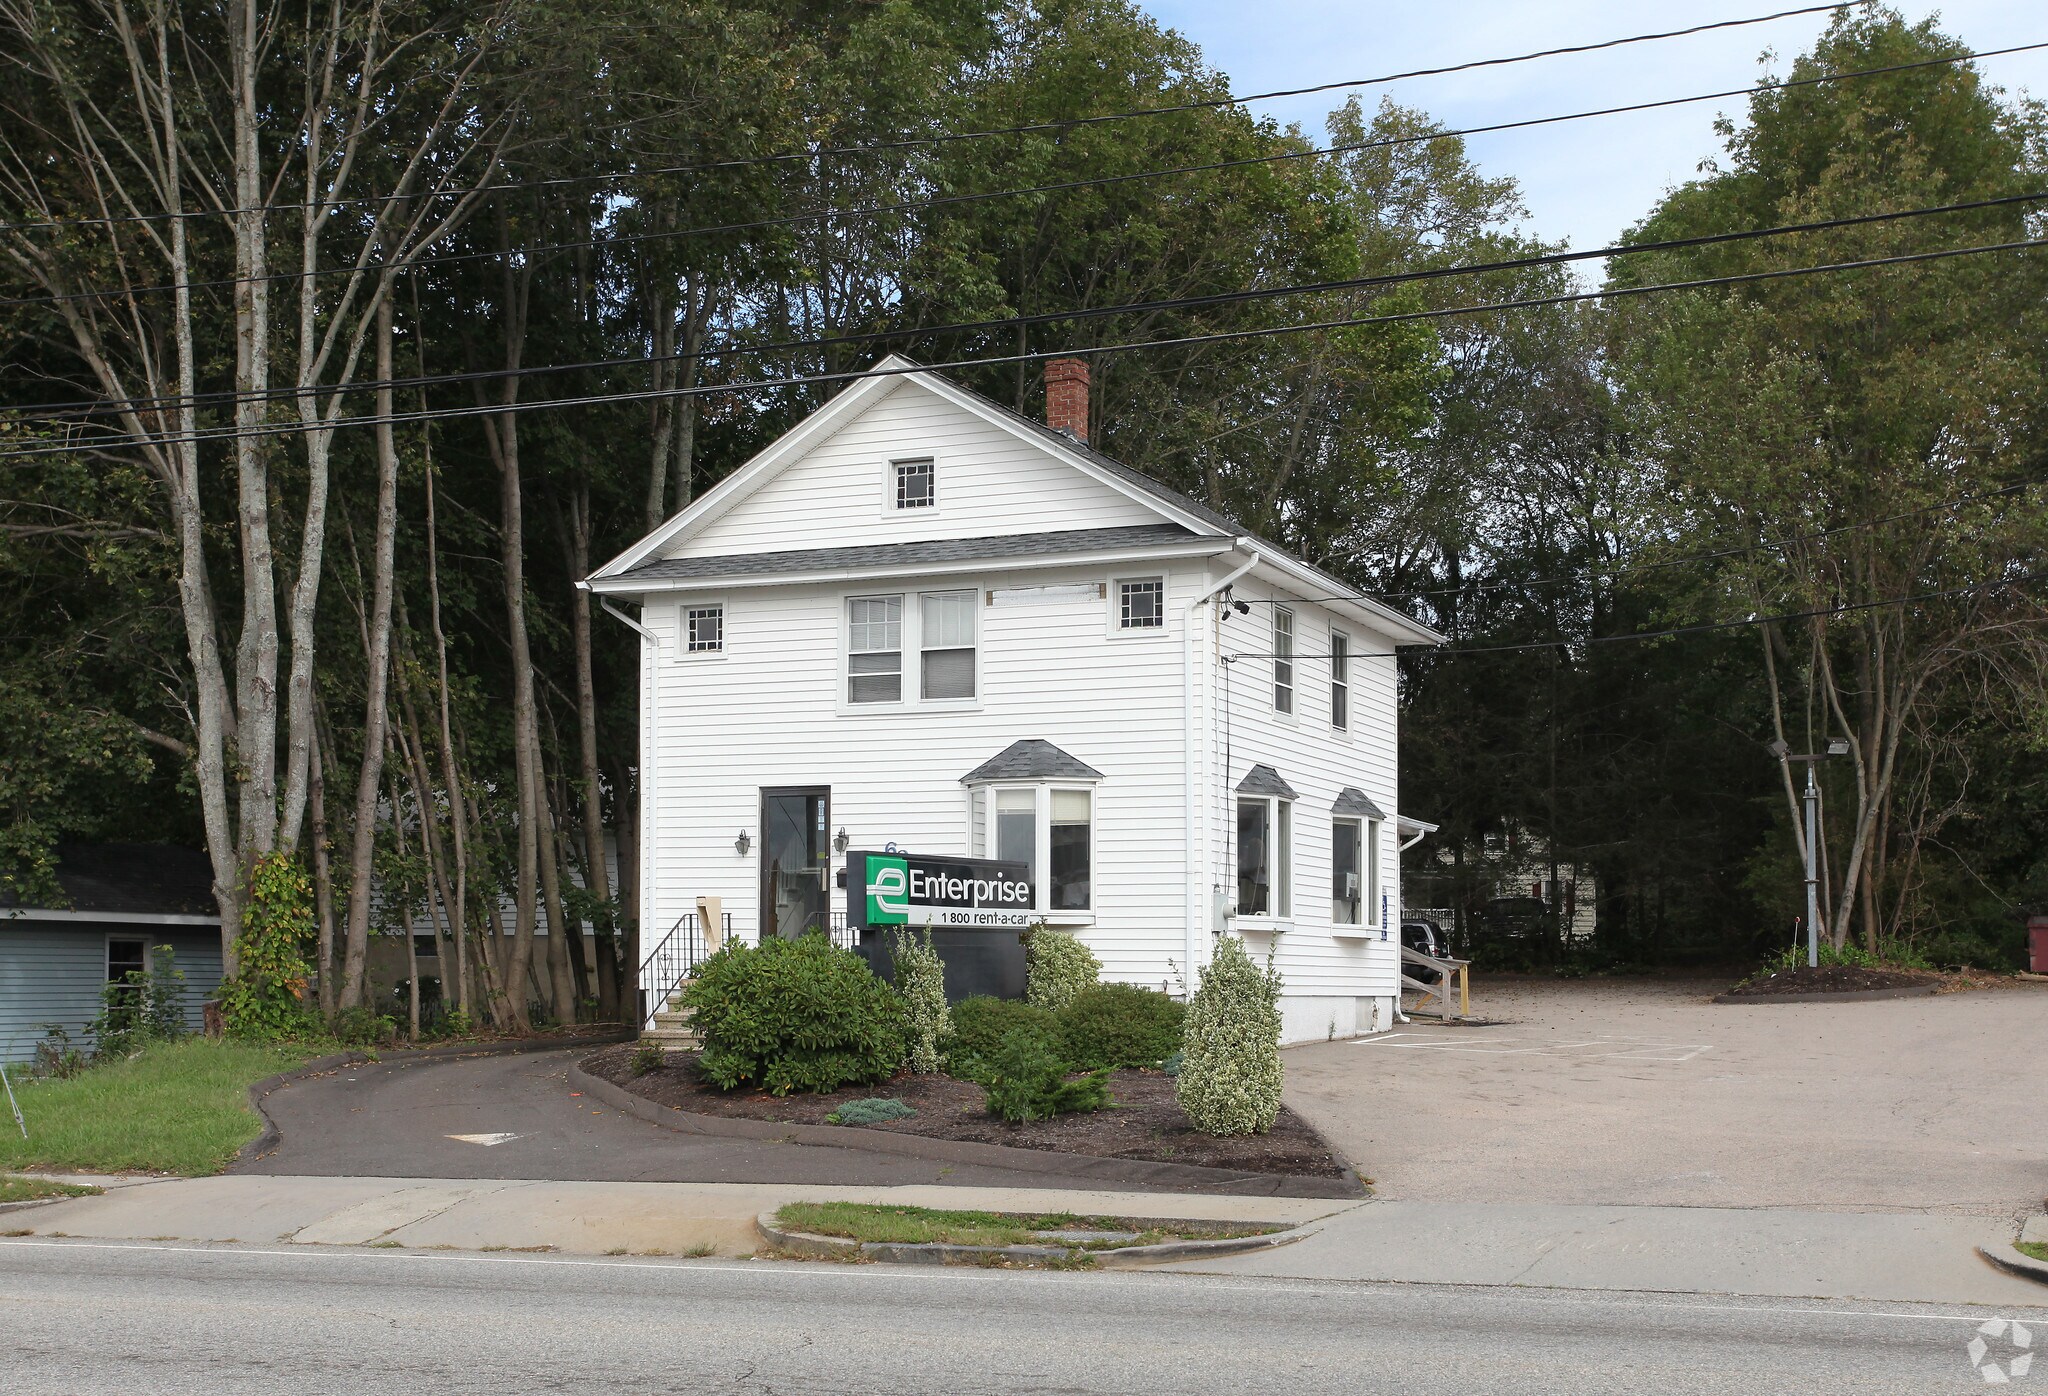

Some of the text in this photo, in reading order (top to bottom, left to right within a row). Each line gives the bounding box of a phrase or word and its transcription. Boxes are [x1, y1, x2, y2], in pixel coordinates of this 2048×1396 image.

[885, 841, 908, 854] 6
[910, 869, 1030, 908] Enterprise
[941, 912, 1029, 925] 1 800 rent-a-car
